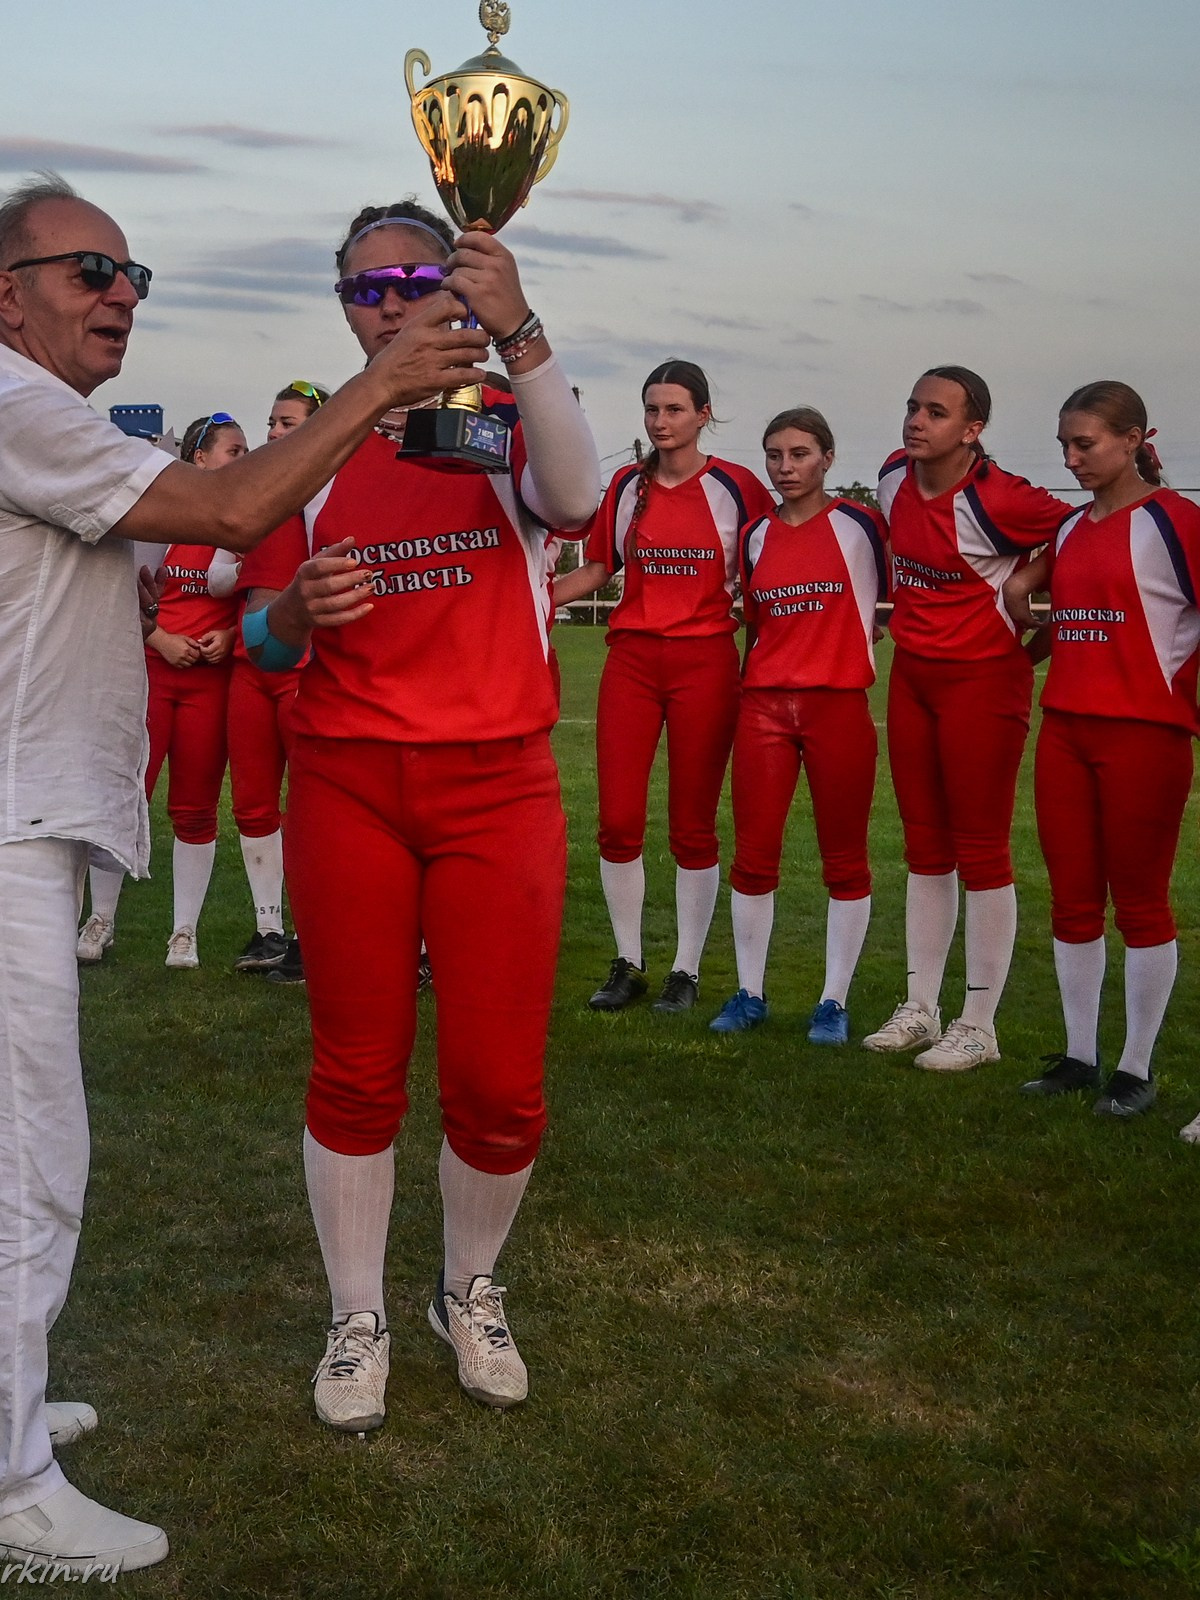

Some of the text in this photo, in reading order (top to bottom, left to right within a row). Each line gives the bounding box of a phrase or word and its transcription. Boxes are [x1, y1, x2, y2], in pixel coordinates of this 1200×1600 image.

[321, 527, 501, 567] осковская
[637, 548, 715, 559] осковская
[355, 565, 473, 597] бласть
